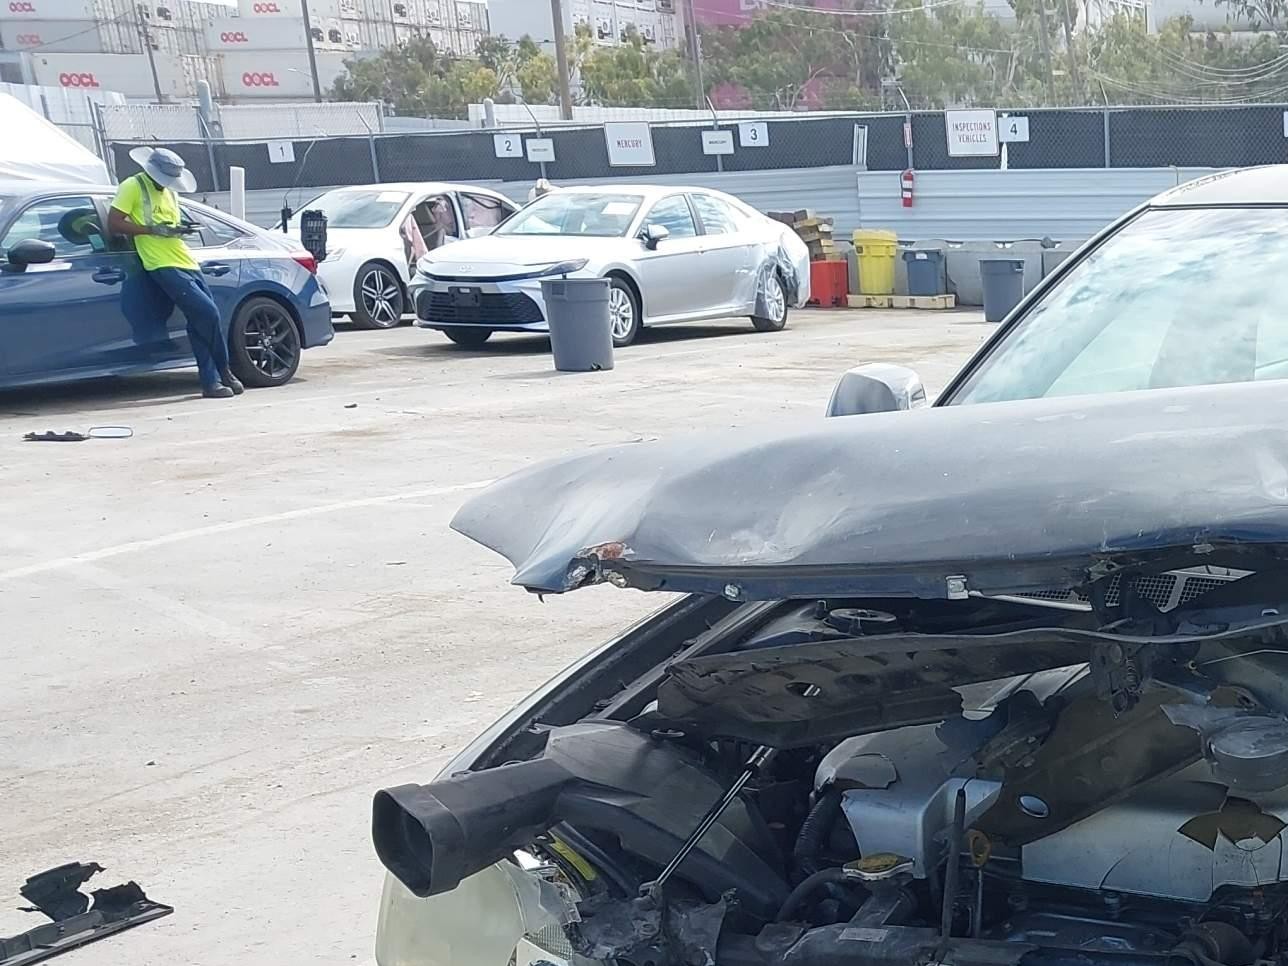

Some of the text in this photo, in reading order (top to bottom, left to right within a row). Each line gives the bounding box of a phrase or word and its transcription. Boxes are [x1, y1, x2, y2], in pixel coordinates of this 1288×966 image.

[9, 2, 35, 12] OOCL
[253, 3, 280, 13] OOCL
[220, 32, 248, 43] OOCL
[59, 73, 99, 87] OOCL
[242, 72, 279, 87] OOCL
[952, 121, 992, 131] INSPECTIONS
[1009, 123, 1018, 135] 4
[750, 128, 758, 141] 3
[958, 134, 987, 143] VEHICLES
[504, 140, 513, 152] 2
[616, 139, 643, 148] MERCURY
